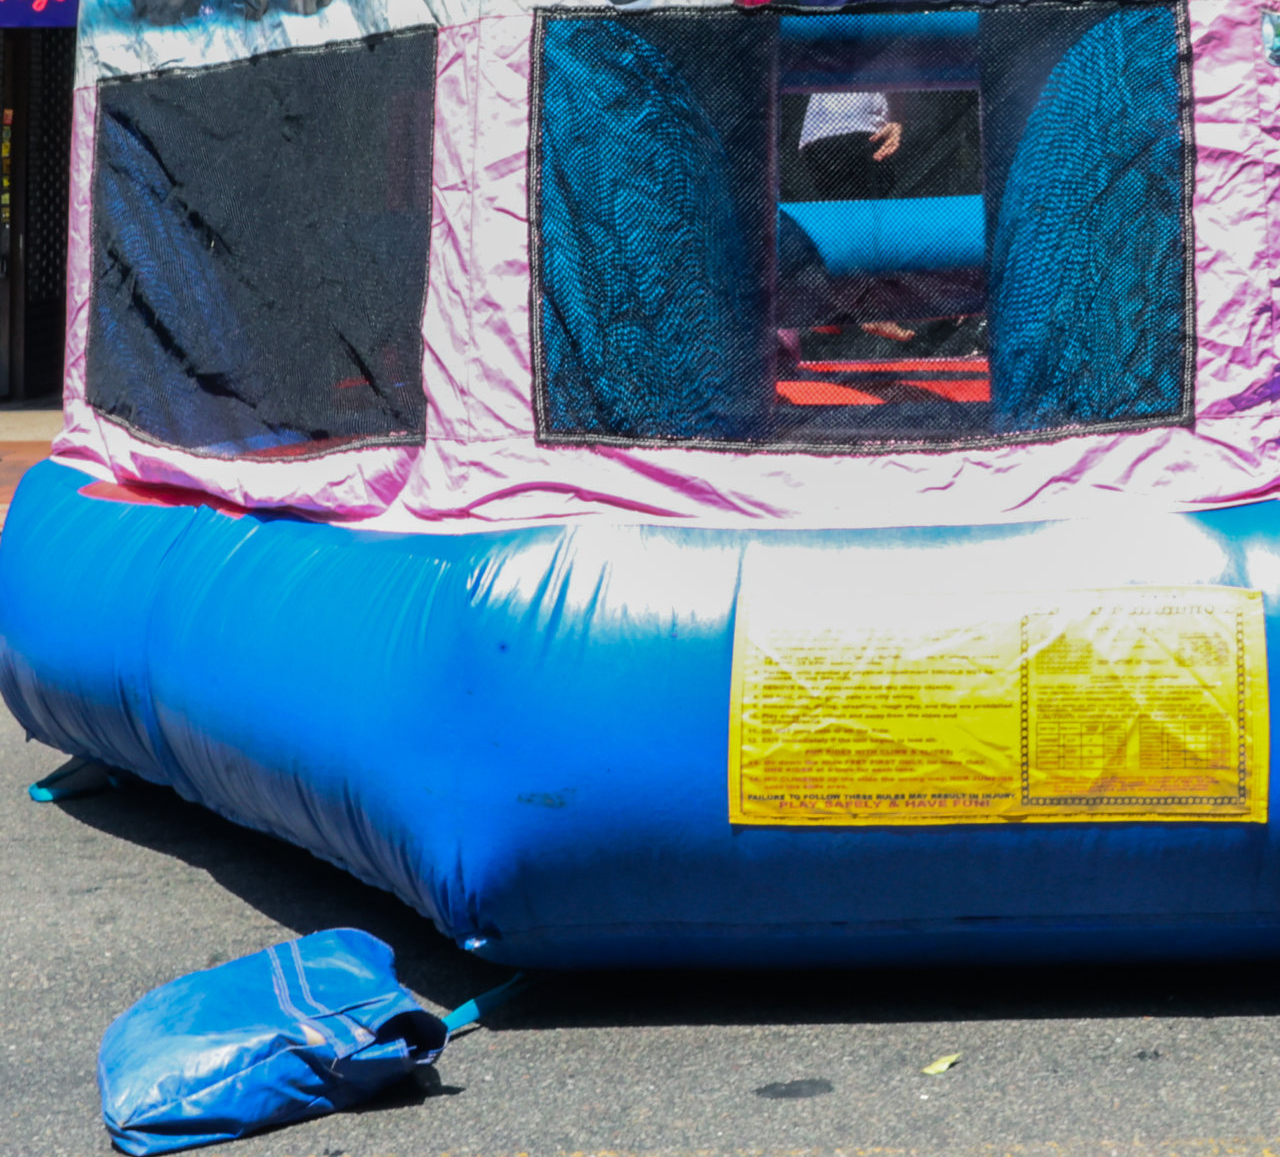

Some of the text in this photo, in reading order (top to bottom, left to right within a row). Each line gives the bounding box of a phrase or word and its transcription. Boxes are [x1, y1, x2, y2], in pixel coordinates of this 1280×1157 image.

[779, 800, 991, 809] PLAY SAFELY & HAVE FUN!
